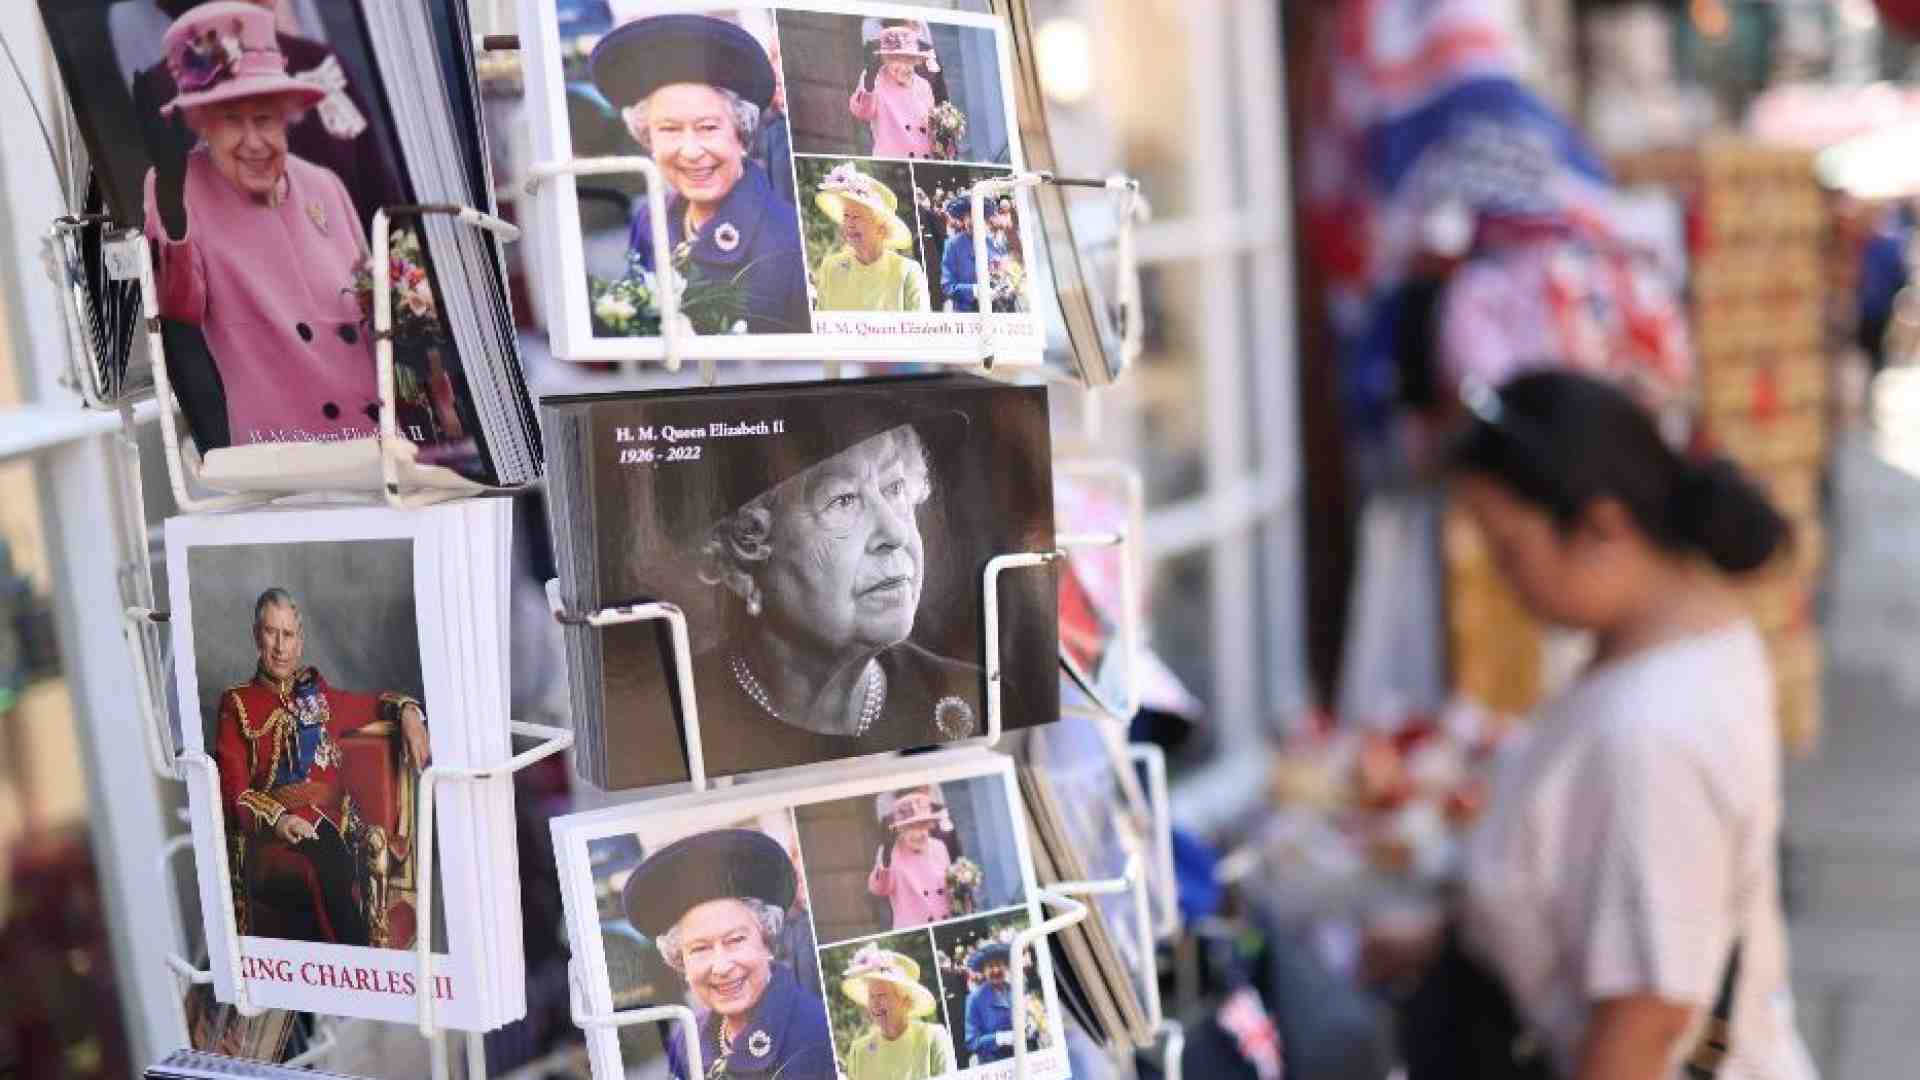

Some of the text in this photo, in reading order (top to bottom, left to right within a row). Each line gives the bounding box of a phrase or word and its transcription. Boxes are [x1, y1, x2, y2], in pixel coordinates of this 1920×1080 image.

[855, 320, 897, 337] Queen
[409, 426, 425, 441] II
[616, 420, 785, 443] H. M. Queen Elizabeth II
[620, 448, 655, 464] 1926
[665, 446, 702, 461] 2022
[300, 961, 417, 996] CHARLES
[432, 976, 455, 1001] II
